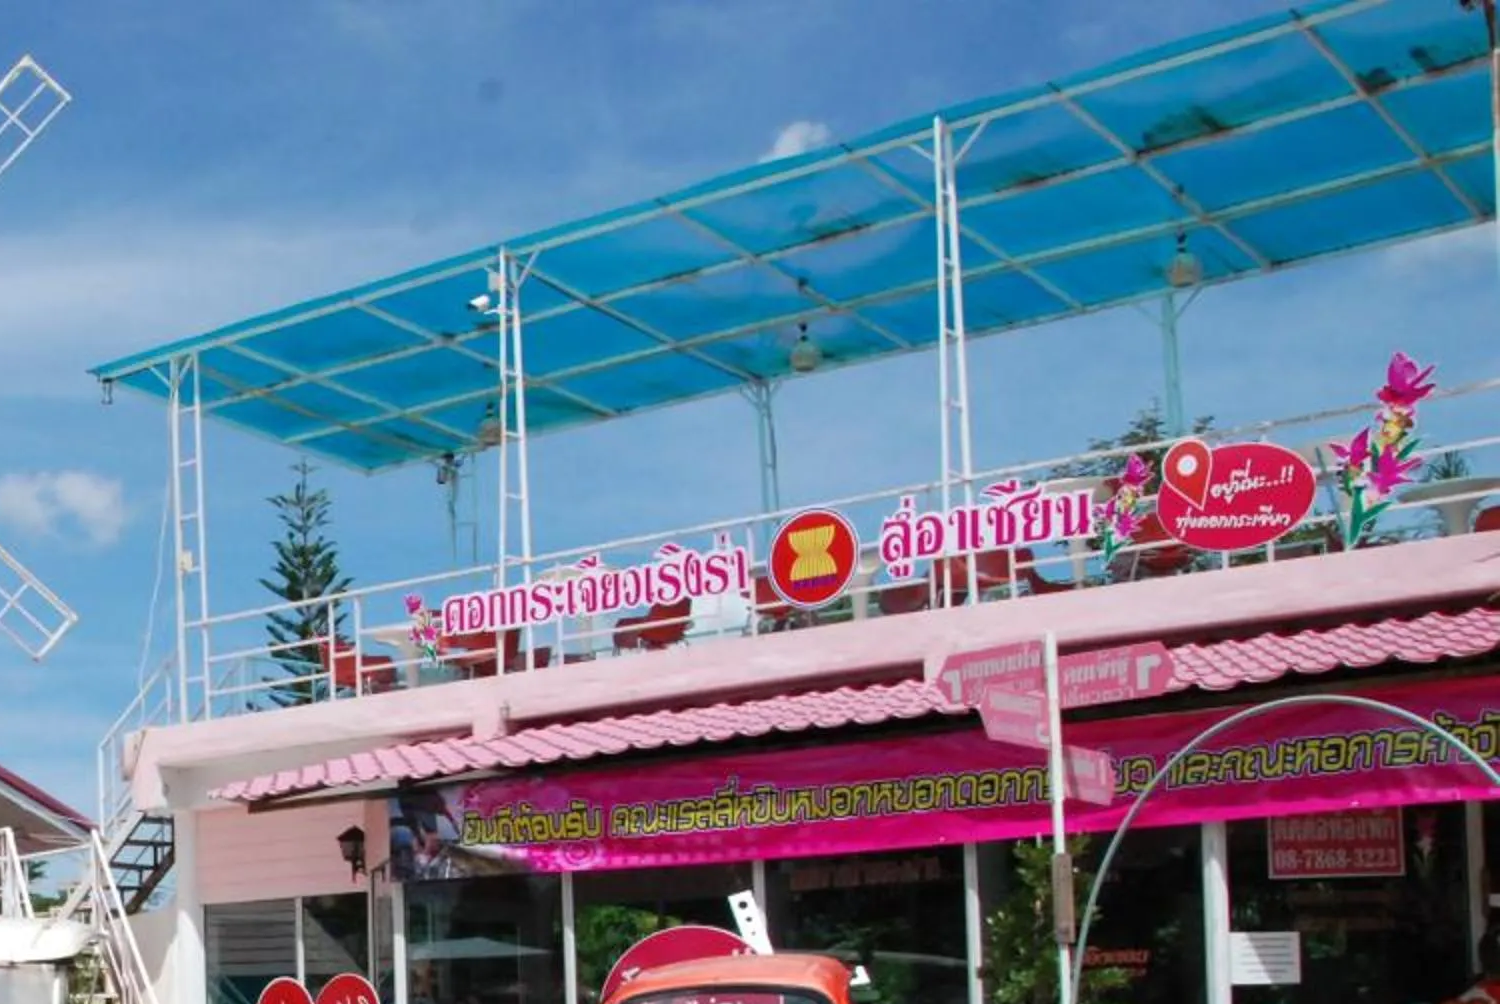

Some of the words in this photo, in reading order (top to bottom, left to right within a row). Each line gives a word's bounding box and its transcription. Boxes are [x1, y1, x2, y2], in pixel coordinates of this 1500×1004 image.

[881, 480, 1090, 577] สู่อาเซียน
[463, 801, 602, 844] ยินดีต้อนรับ
